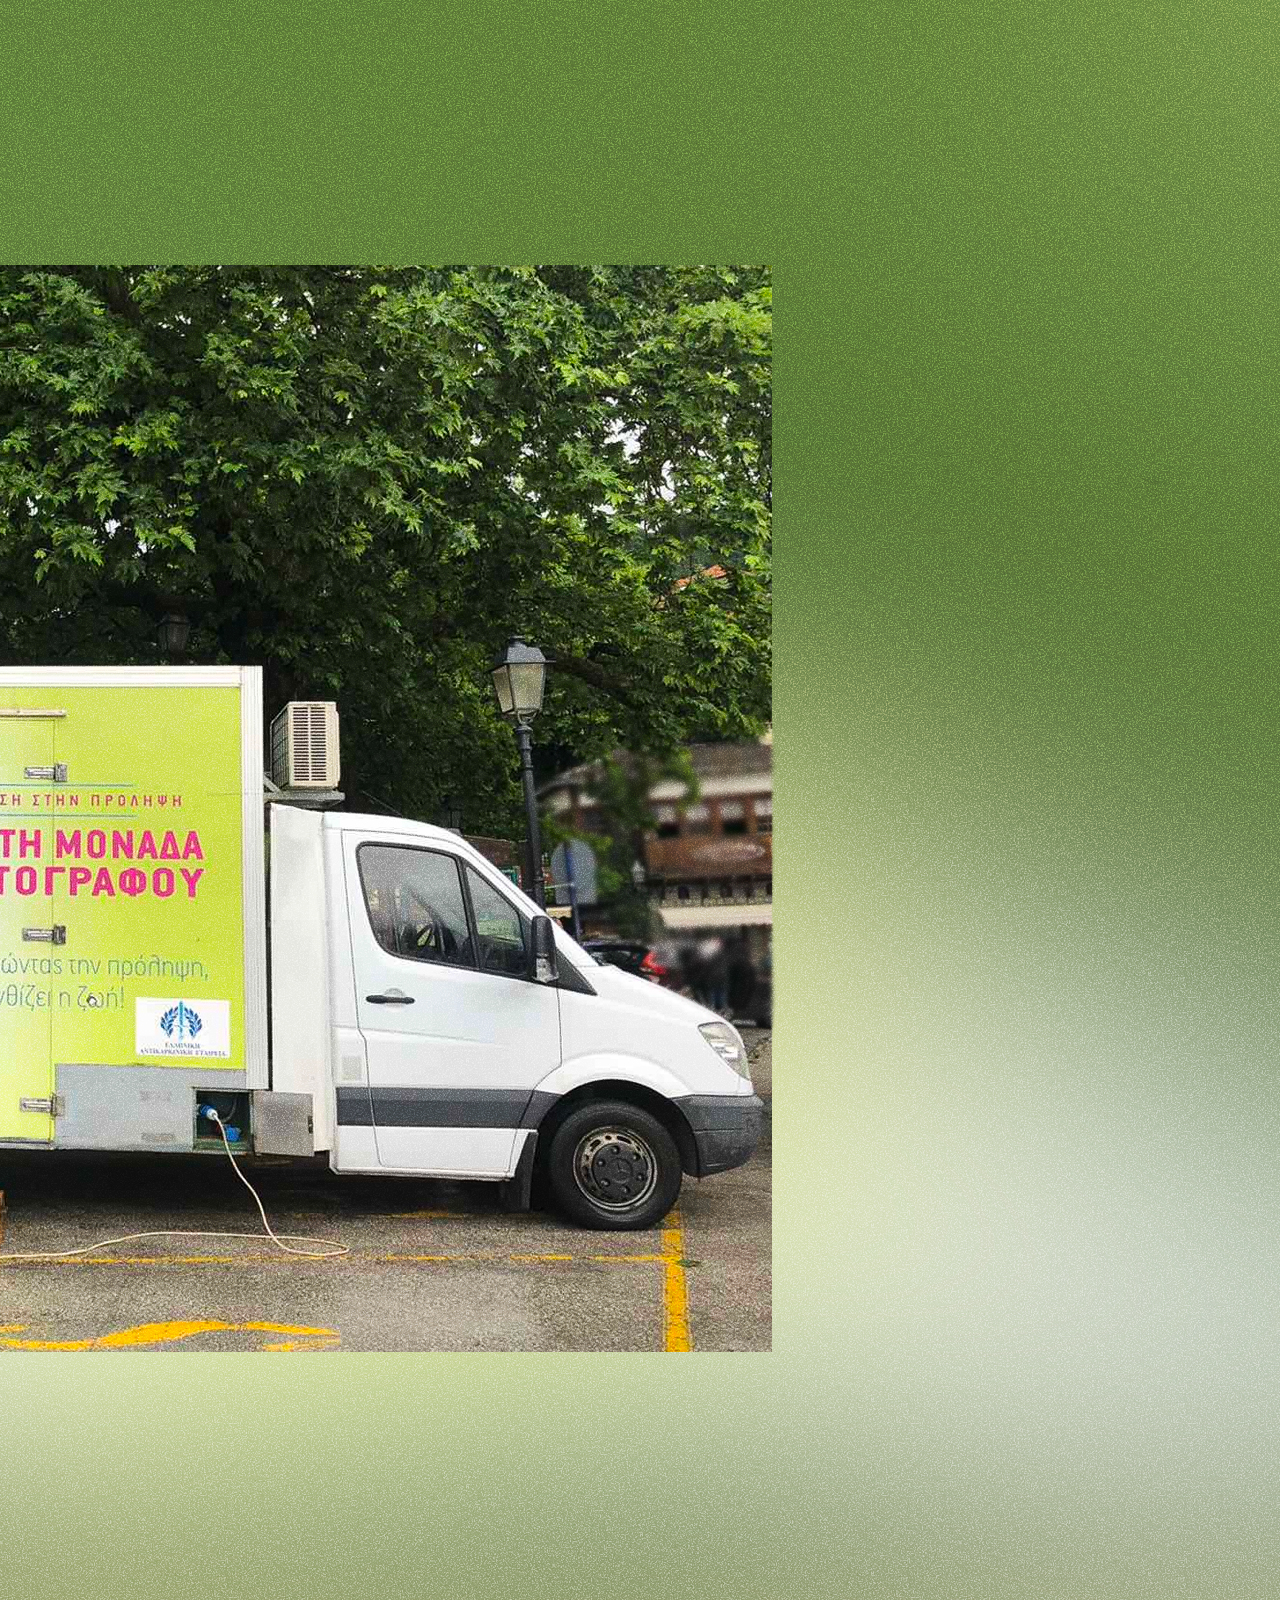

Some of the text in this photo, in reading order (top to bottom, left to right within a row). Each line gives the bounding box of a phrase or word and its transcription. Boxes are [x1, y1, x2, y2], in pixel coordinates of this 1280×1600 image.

[32, 793, 79, 807] ΣΤΗΝ
[91, 794, 183, 808] ΠΡΟΛΗΨΗ
[55, 828, 204, 860] ΜΟΝΑΔΑ
[69, 958, 101, 975] την
[107, 955, 209, 982] πρόληψη,
[58, 992, 71, 1007] η
[76, 985, 125, 1012] ζωή!
